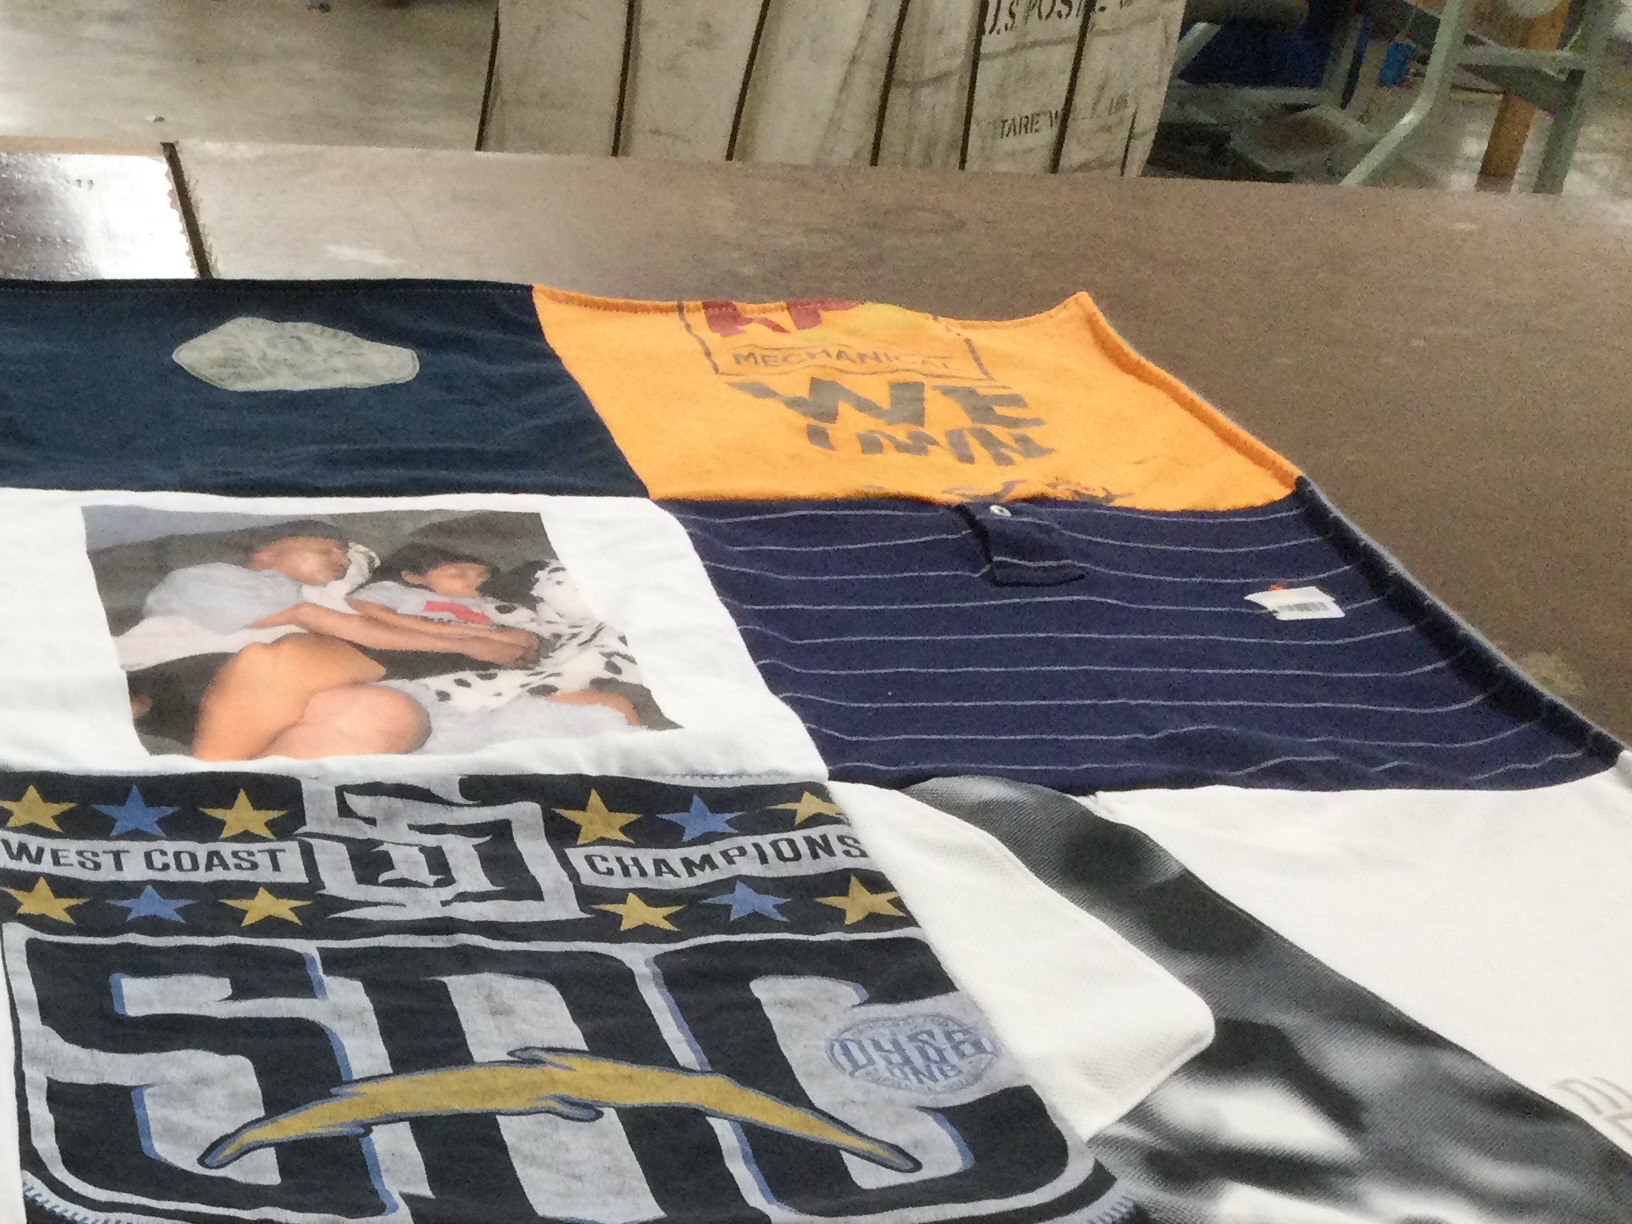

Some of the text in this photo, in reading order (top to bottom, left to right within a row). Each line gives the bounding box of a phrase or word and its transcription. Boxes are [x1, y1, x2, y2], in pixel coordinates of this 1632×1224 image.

[1, 838, 286, 874] WEST COAST
[583, 833, 869, 879] CHAMPIONS
